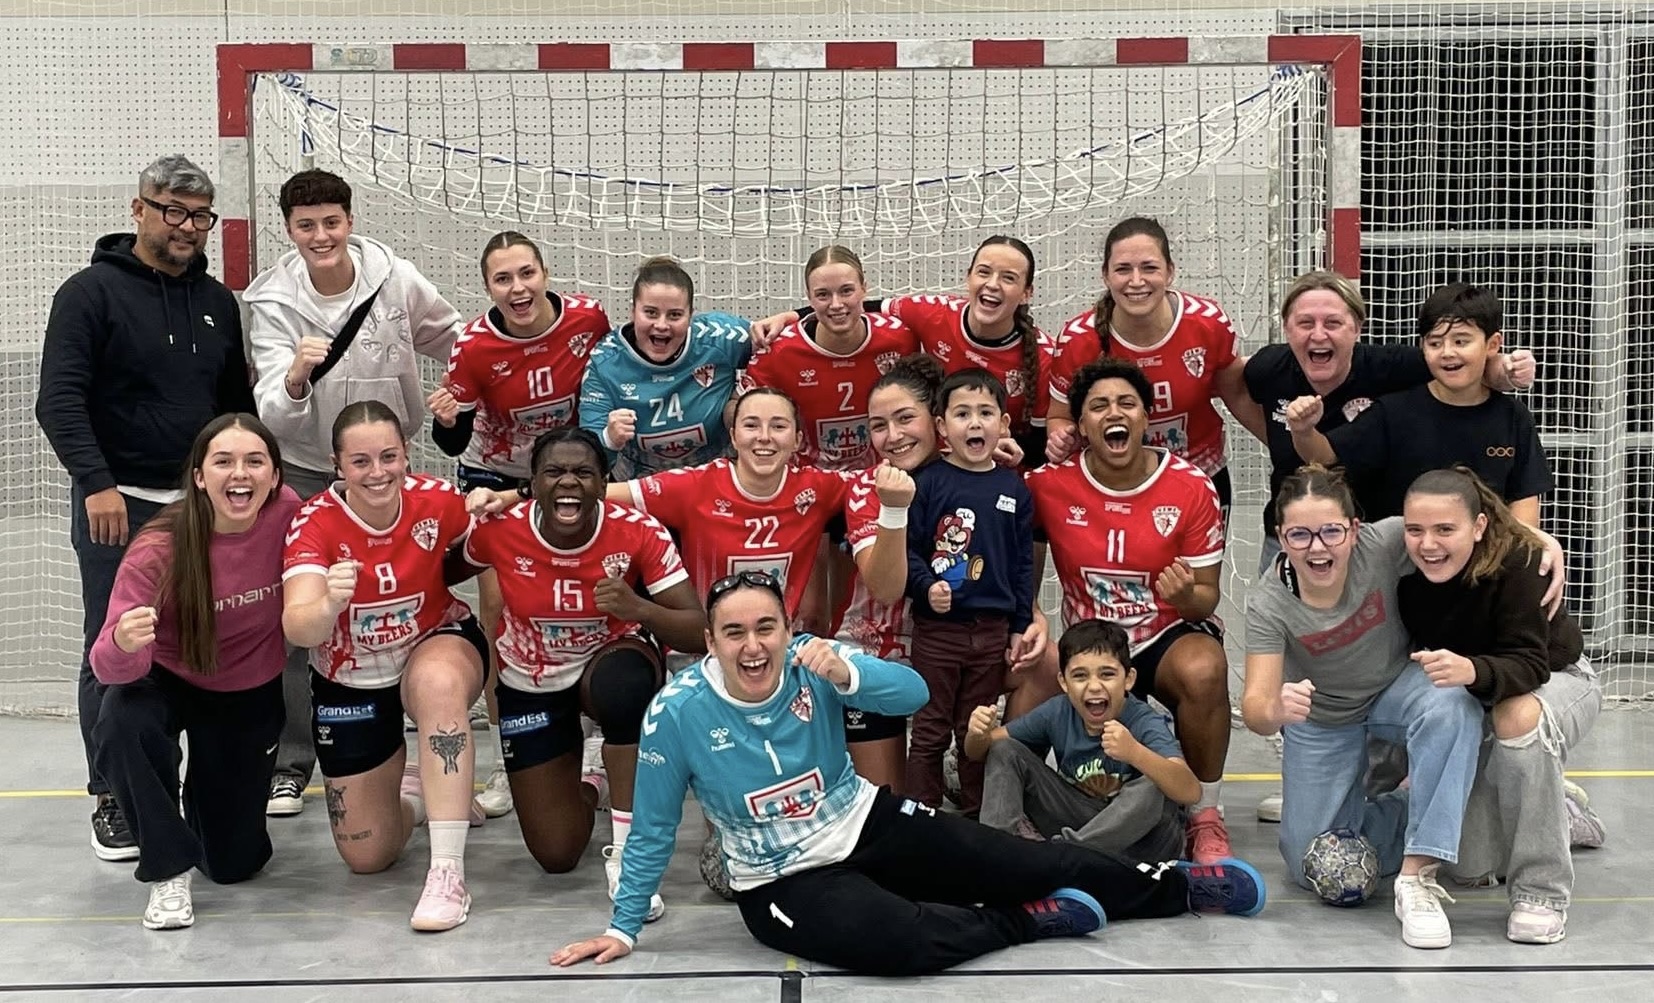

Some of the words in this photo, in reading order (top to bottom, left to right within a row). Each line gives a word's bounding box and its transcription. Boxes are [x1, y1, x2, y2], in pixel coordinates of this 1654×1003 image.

[527, 366, 554, 399] 10
[837, 382, 855, 412] 2
[649, 393, 684, 427] 24
[744, 516, 780, 549] 22
[1107, 528, 1126, 563] 11
[375, 562, 397, 595] 8
[553, 578, 584, 612] 15
[356, 633, 376, 646] MY
[377, 622, 414, 645] BEERS
[763, 739, 783, 777] 1
